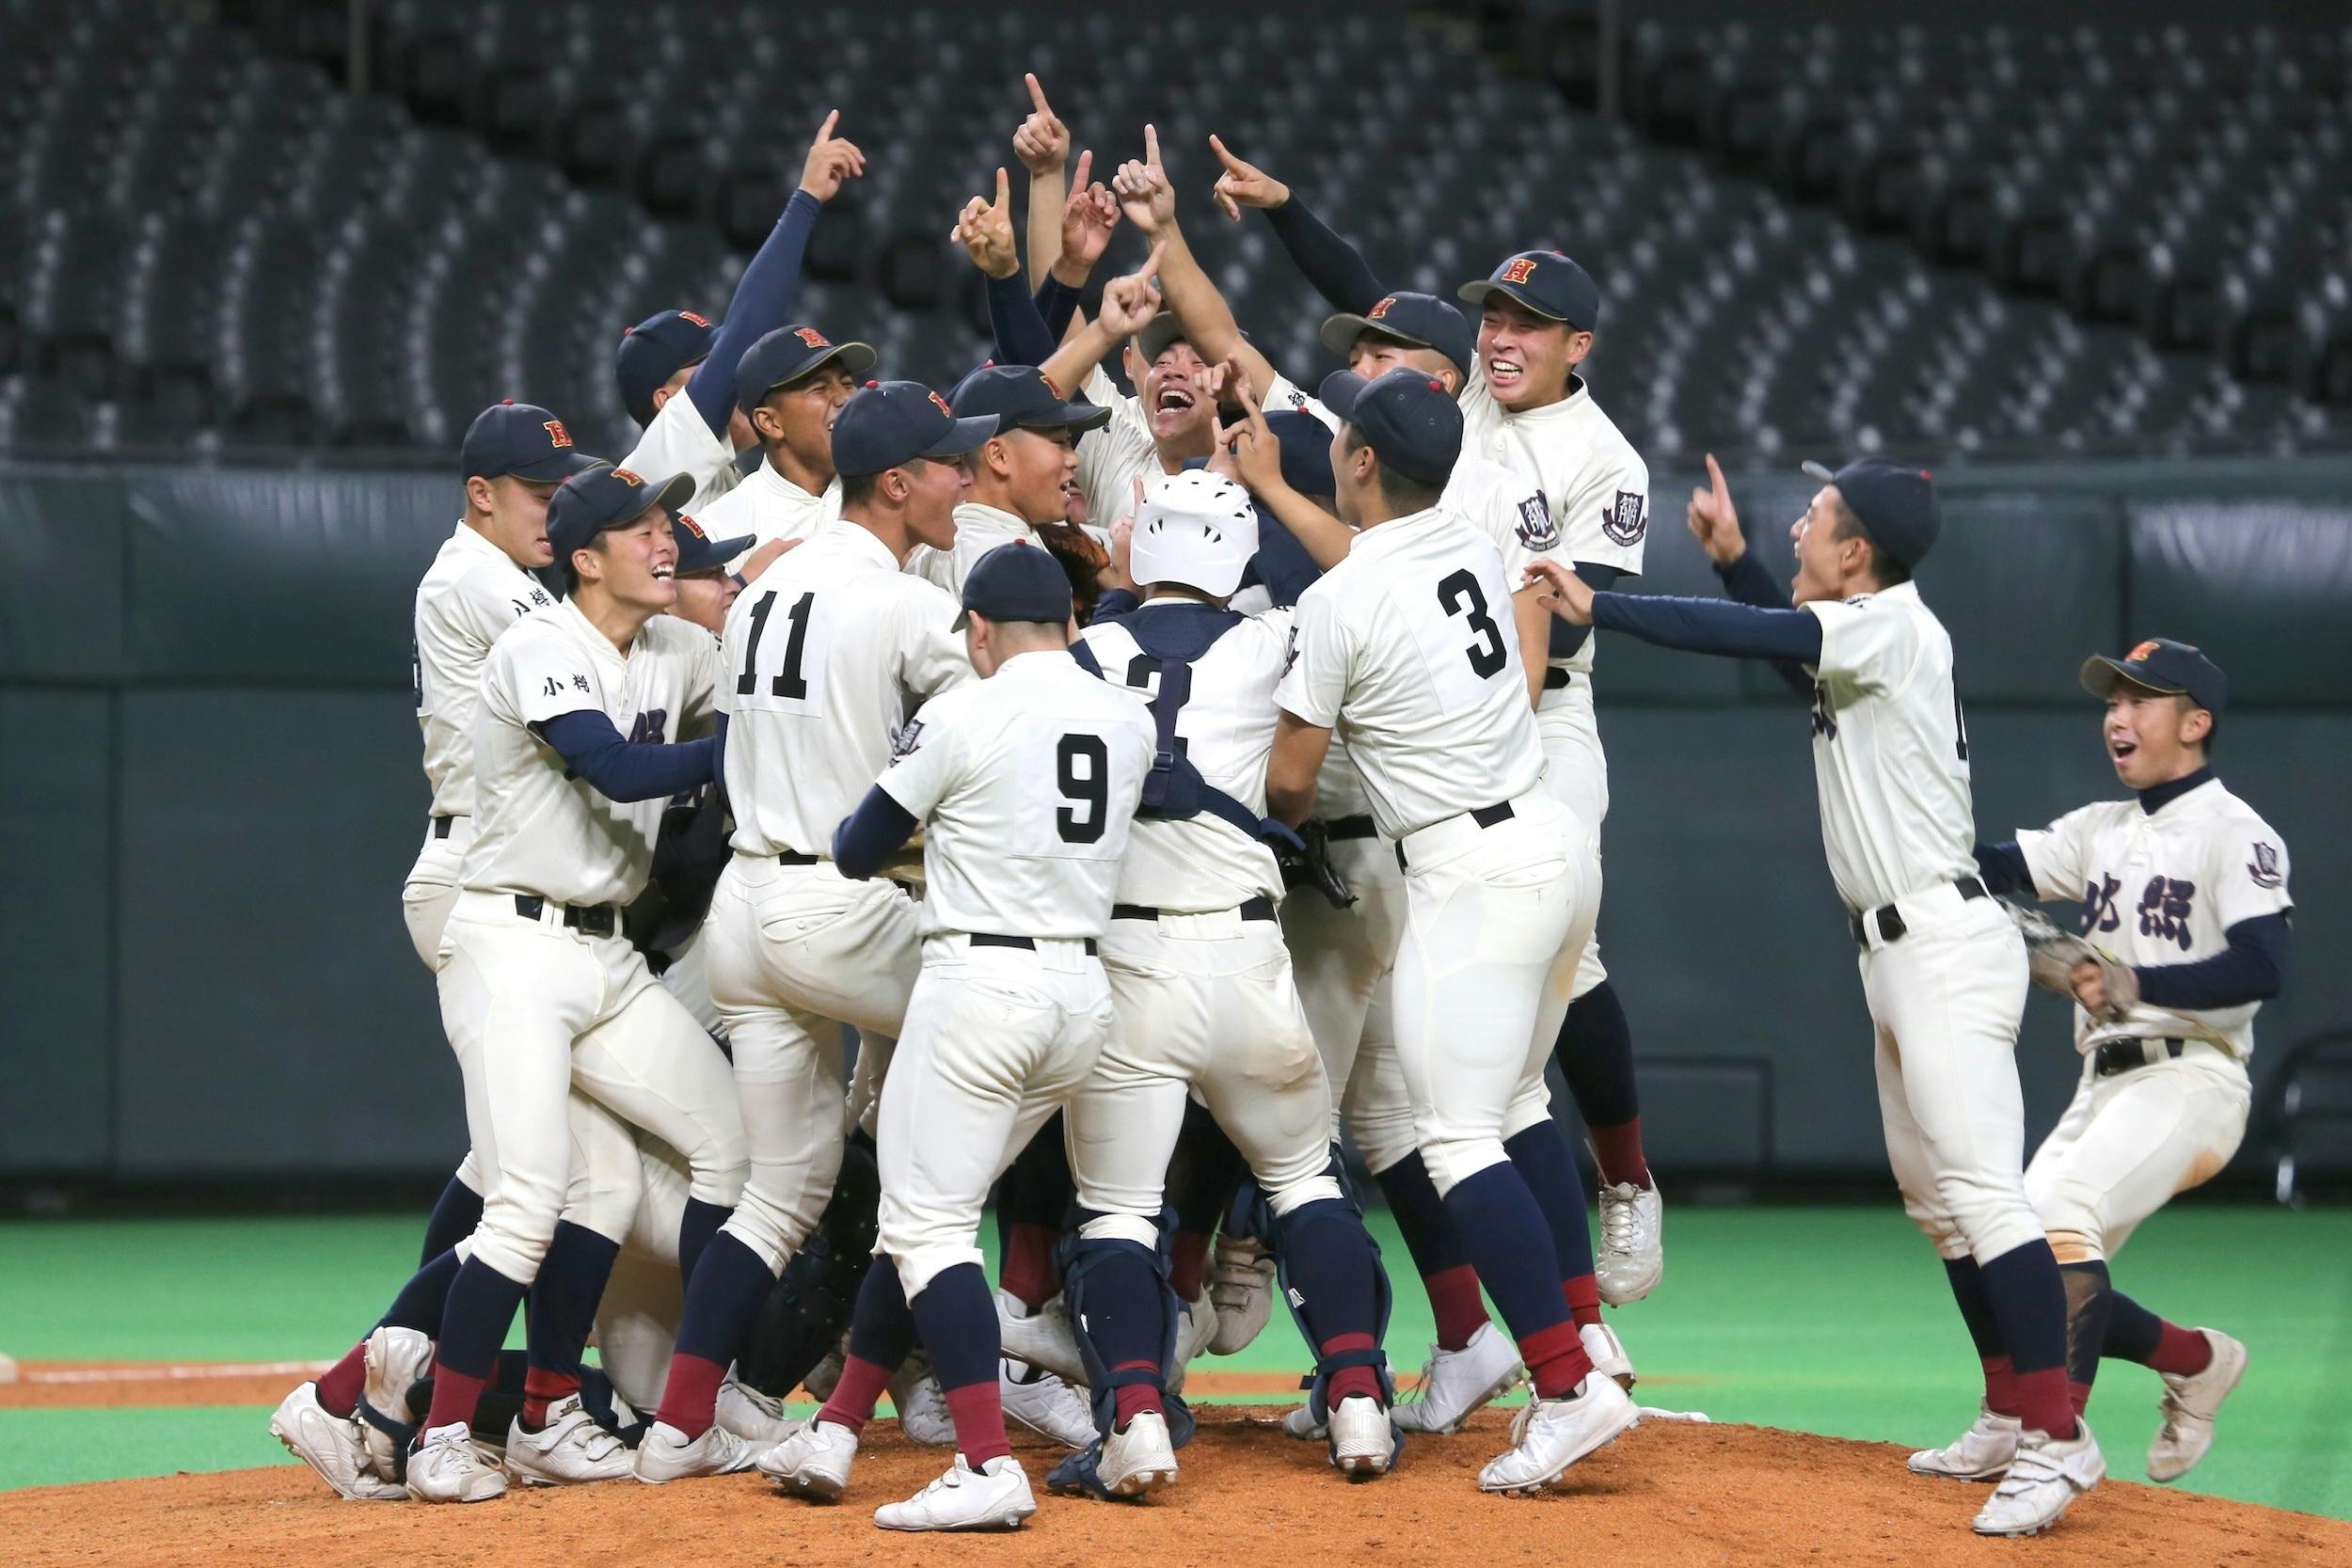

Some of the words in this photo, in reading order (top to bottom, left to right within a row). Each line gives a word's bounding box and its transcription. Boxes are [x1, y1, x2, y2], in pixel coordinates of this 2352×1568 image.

[1502, 258, 1537, 284] H
[543, 420, 573, 449] H
[737, 590, 815, 700] 11
[1437, 567, 1507, 680] 3
[1056, 733, 1108, 844] 9
